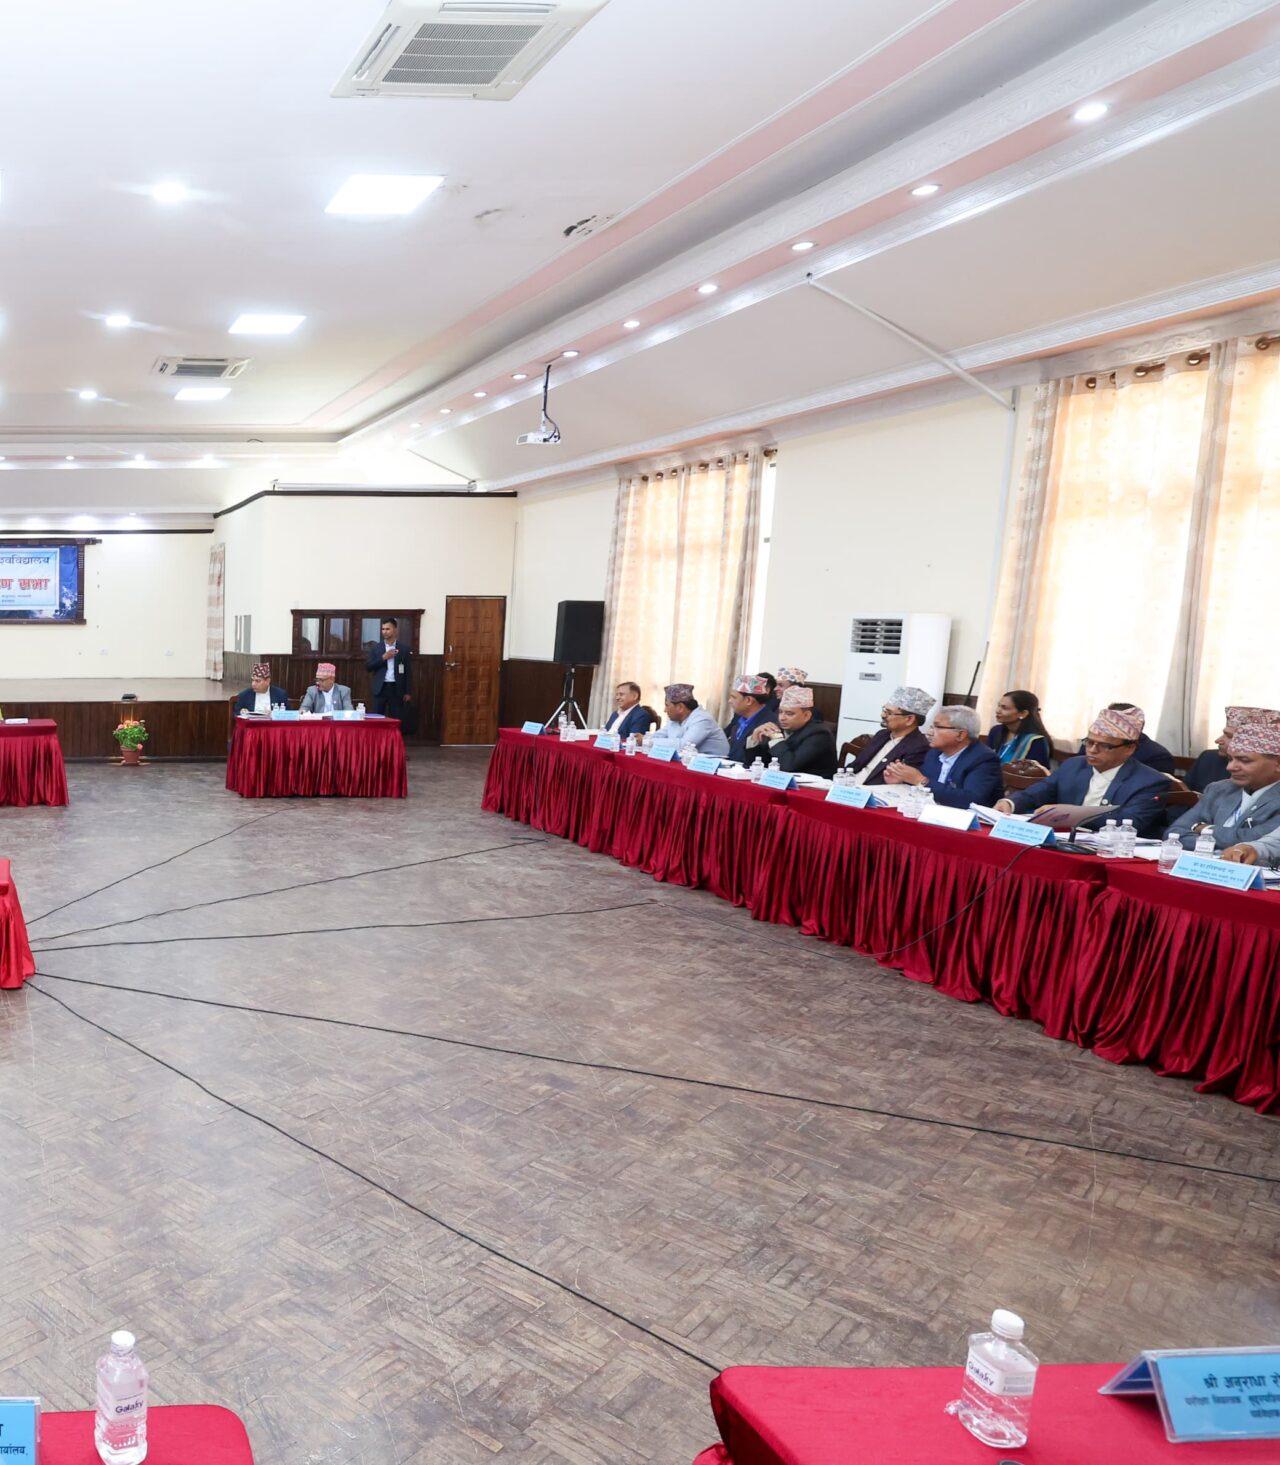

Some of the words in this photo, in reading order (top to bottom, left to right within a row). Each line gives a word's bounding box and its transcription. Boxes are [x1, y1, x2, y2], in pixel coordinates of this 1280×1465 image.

[18, 578, 50, 591] सभा
[1203, 1373, 1218, 1388] श्री
[1223, 1376, 1266, 1392] अनुराधा
[115, 1400, 144, 1414] Galaxy
